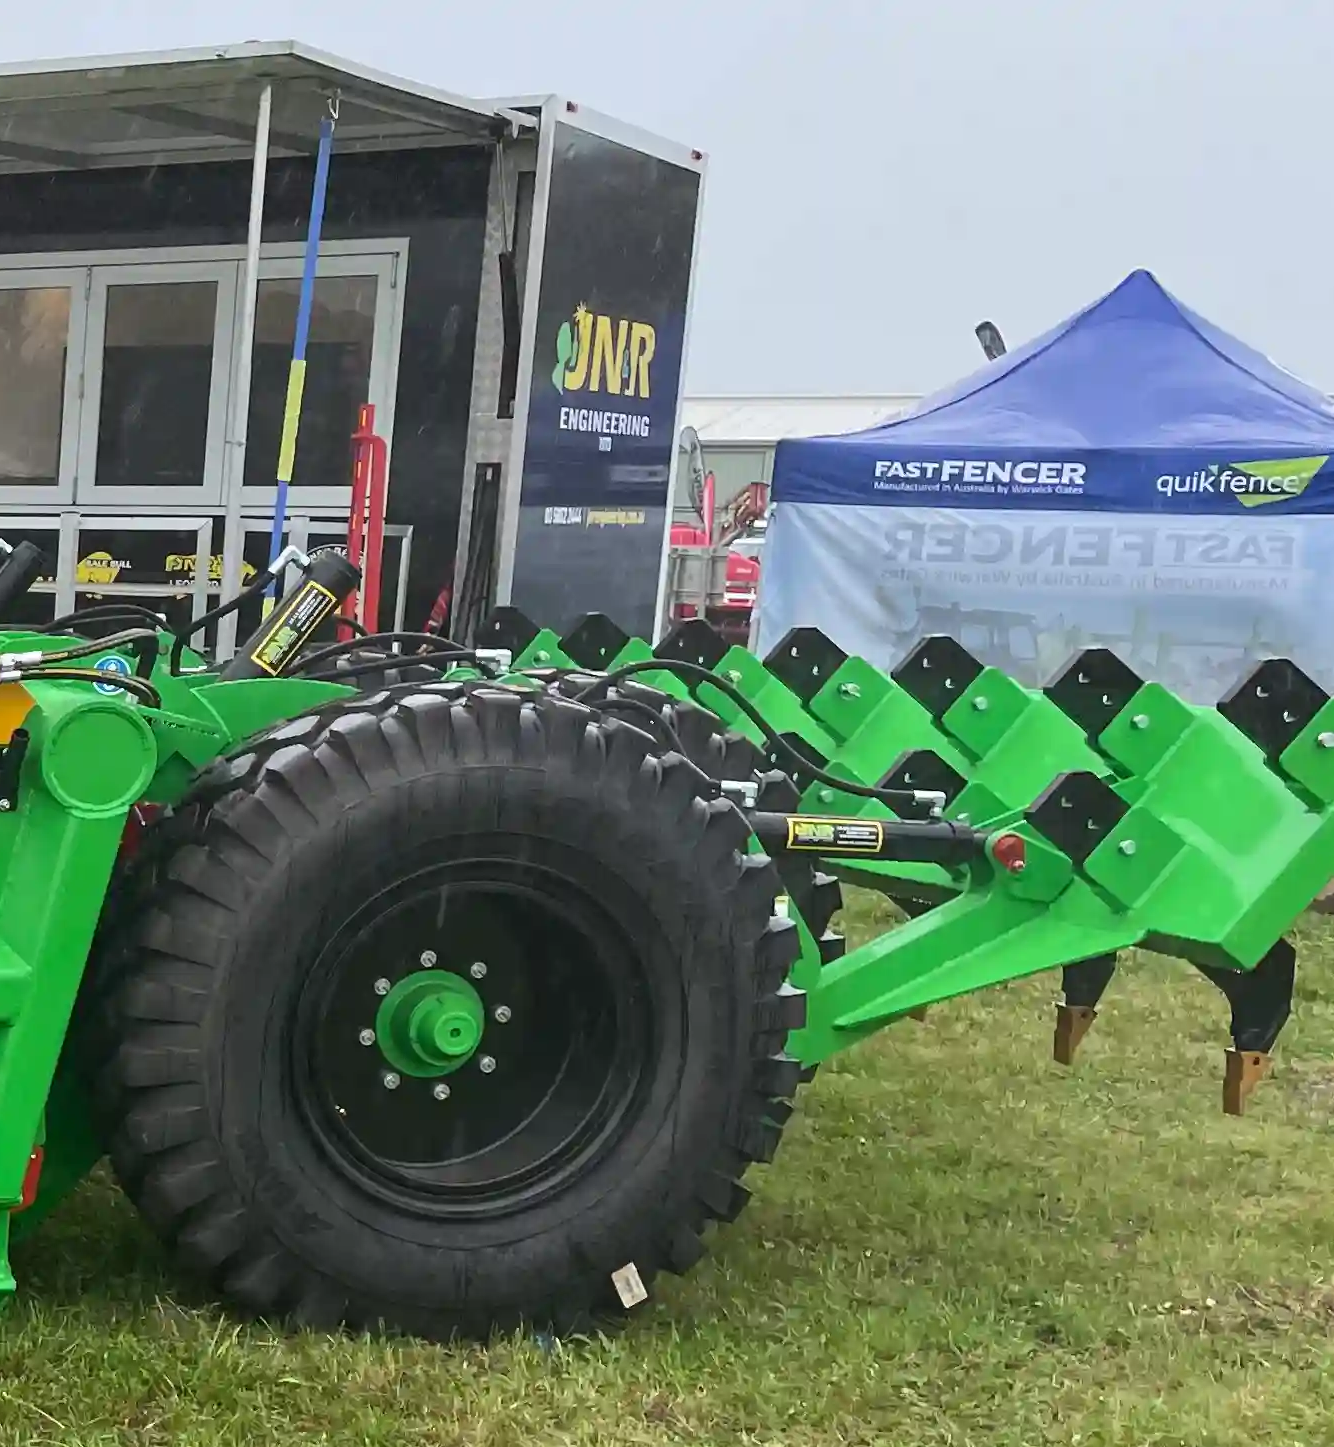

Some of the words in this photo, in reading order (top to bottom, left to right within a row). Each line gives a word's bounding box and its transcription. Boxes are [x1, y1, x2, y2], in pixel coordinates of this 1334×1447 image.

[559, 406, 650, 437] ENGINEERING
[873, 481, 940, 492] Manufactured
[942, 483, 951, 491] in
[954, 483, 995, 493] Australia
[997, 484, 1009, 495] by
[1011, 484, 1052, 494] Warwick
[1055, 485, 1084, 495] Gates
[110, 560, 132, 569] BULL
[169, 579, 219, 587] LEOPRD
